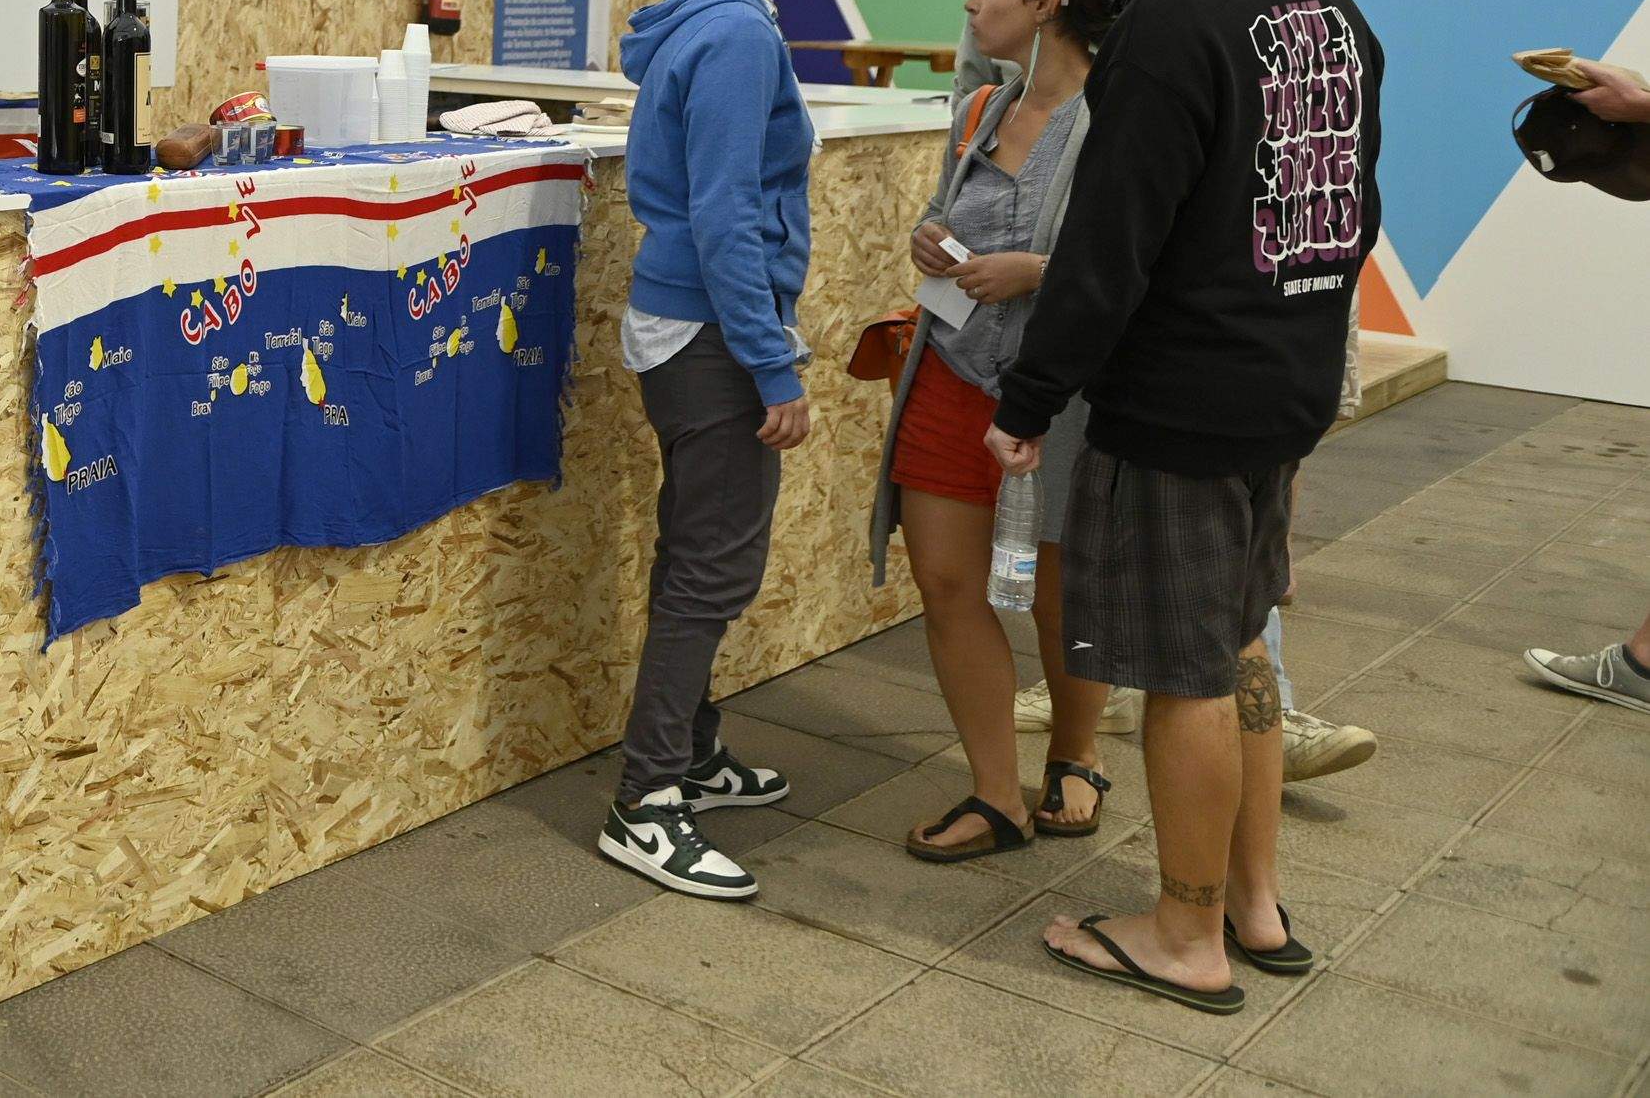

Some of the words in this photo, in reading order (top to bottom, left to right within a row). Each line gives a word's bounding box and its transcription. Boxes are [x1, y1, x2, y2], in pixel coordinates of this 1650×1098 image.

[408, 233, 471, 320] CABO
[1283, 278, 1302, 297] STATE
[1301, 277, 1313, 293] OF
[1312, 275, 1336, 292] MIND
[180, 258, 258, 345] CABO
[264, 327, 302, 350] Tarrafal
[318, 320, 335, 337] São
[102, 345, 133, 369] Maio
[211, 355, 230, 371] São
[248, 379, 272, 396] Fogo
[66, 454, 119, 495] PRAIA
